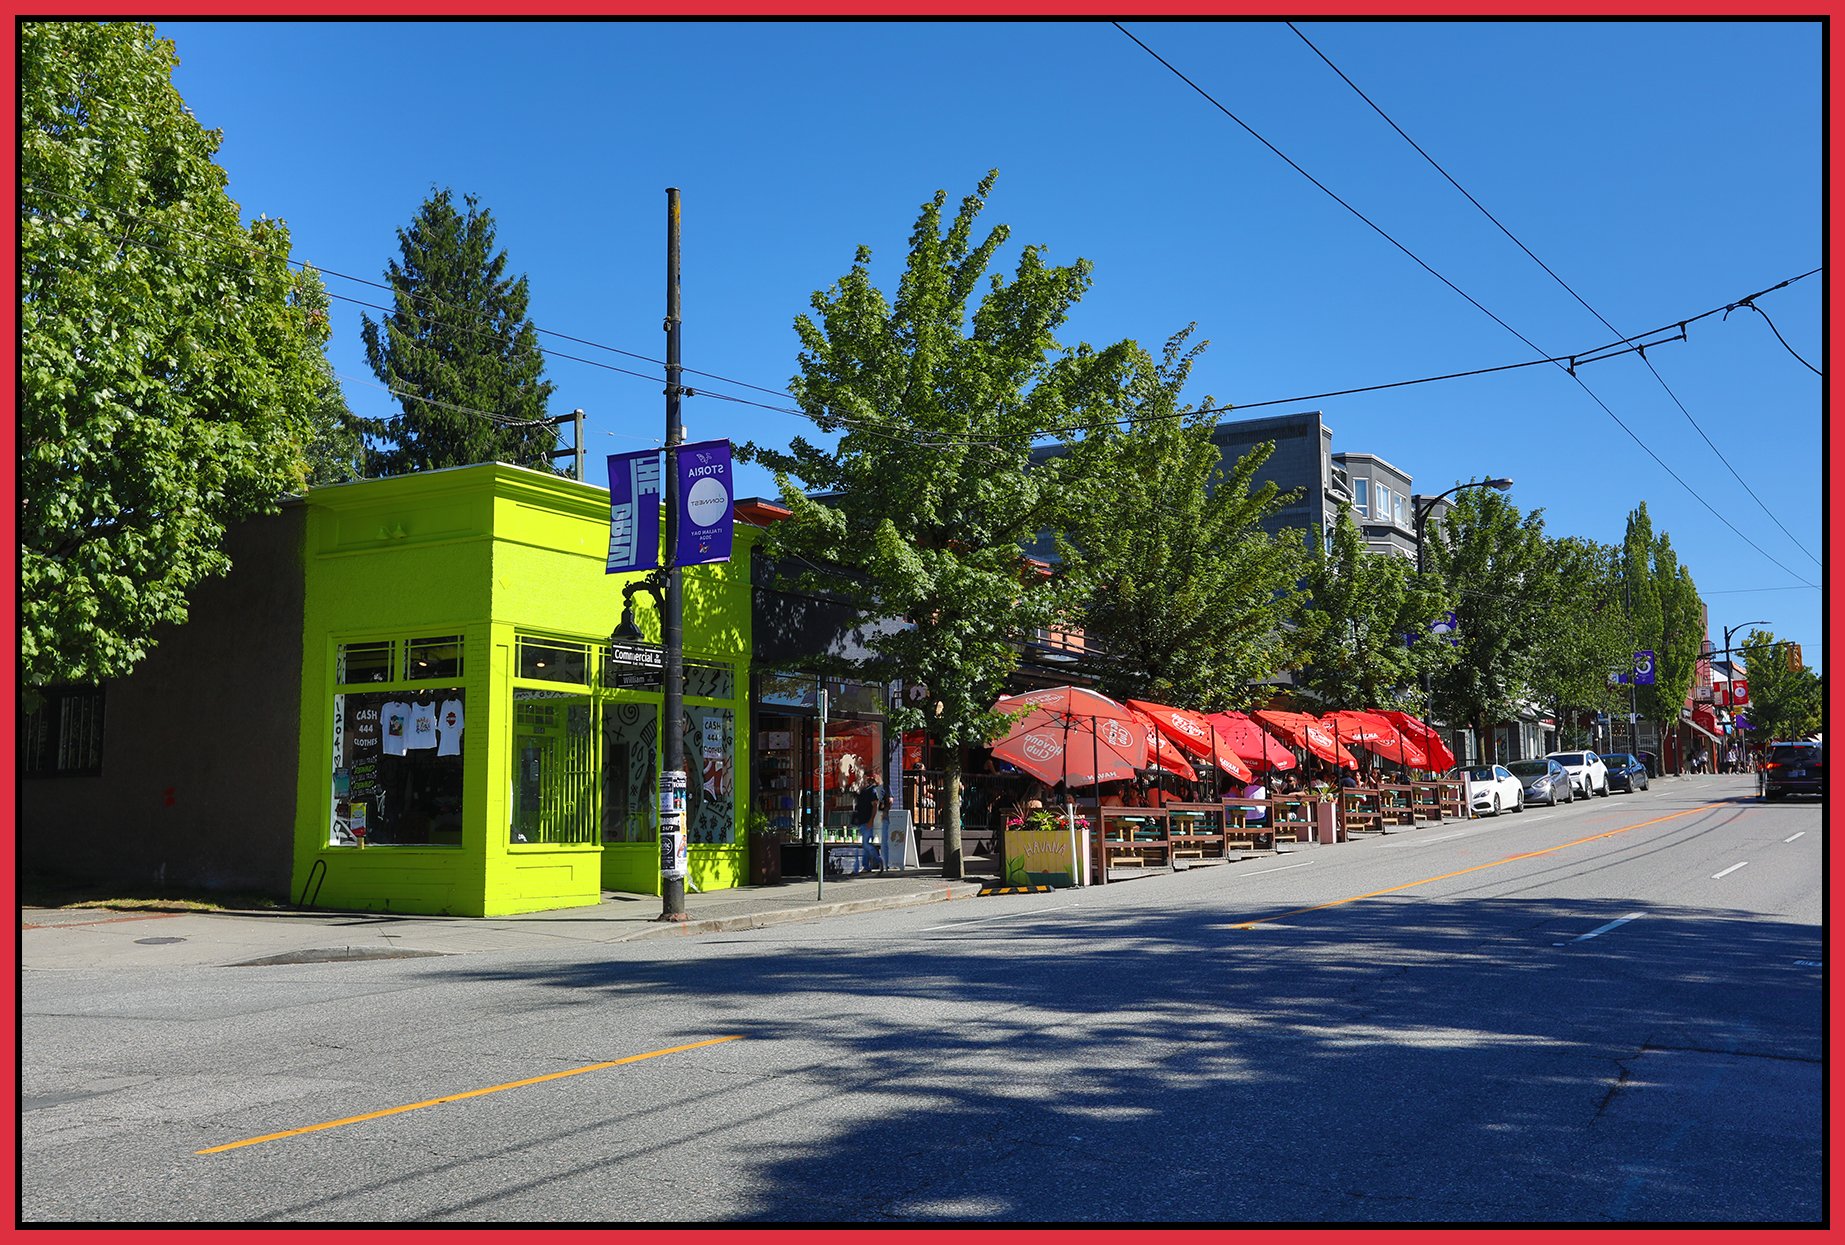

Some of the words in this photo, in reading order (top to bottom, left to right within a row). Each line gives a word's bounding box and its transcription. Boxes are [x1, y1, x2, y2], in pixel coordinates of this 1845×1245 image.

[614, 649, 653, 663] Commercial
[356, 709, 378, 720] CASH
[358, 724, 374, 733] 444
[704, 721, 721, 730] CASH
[353, 737, 378, 747] CLOTHES
[1023, 840, 1067, 857] HAVANA
